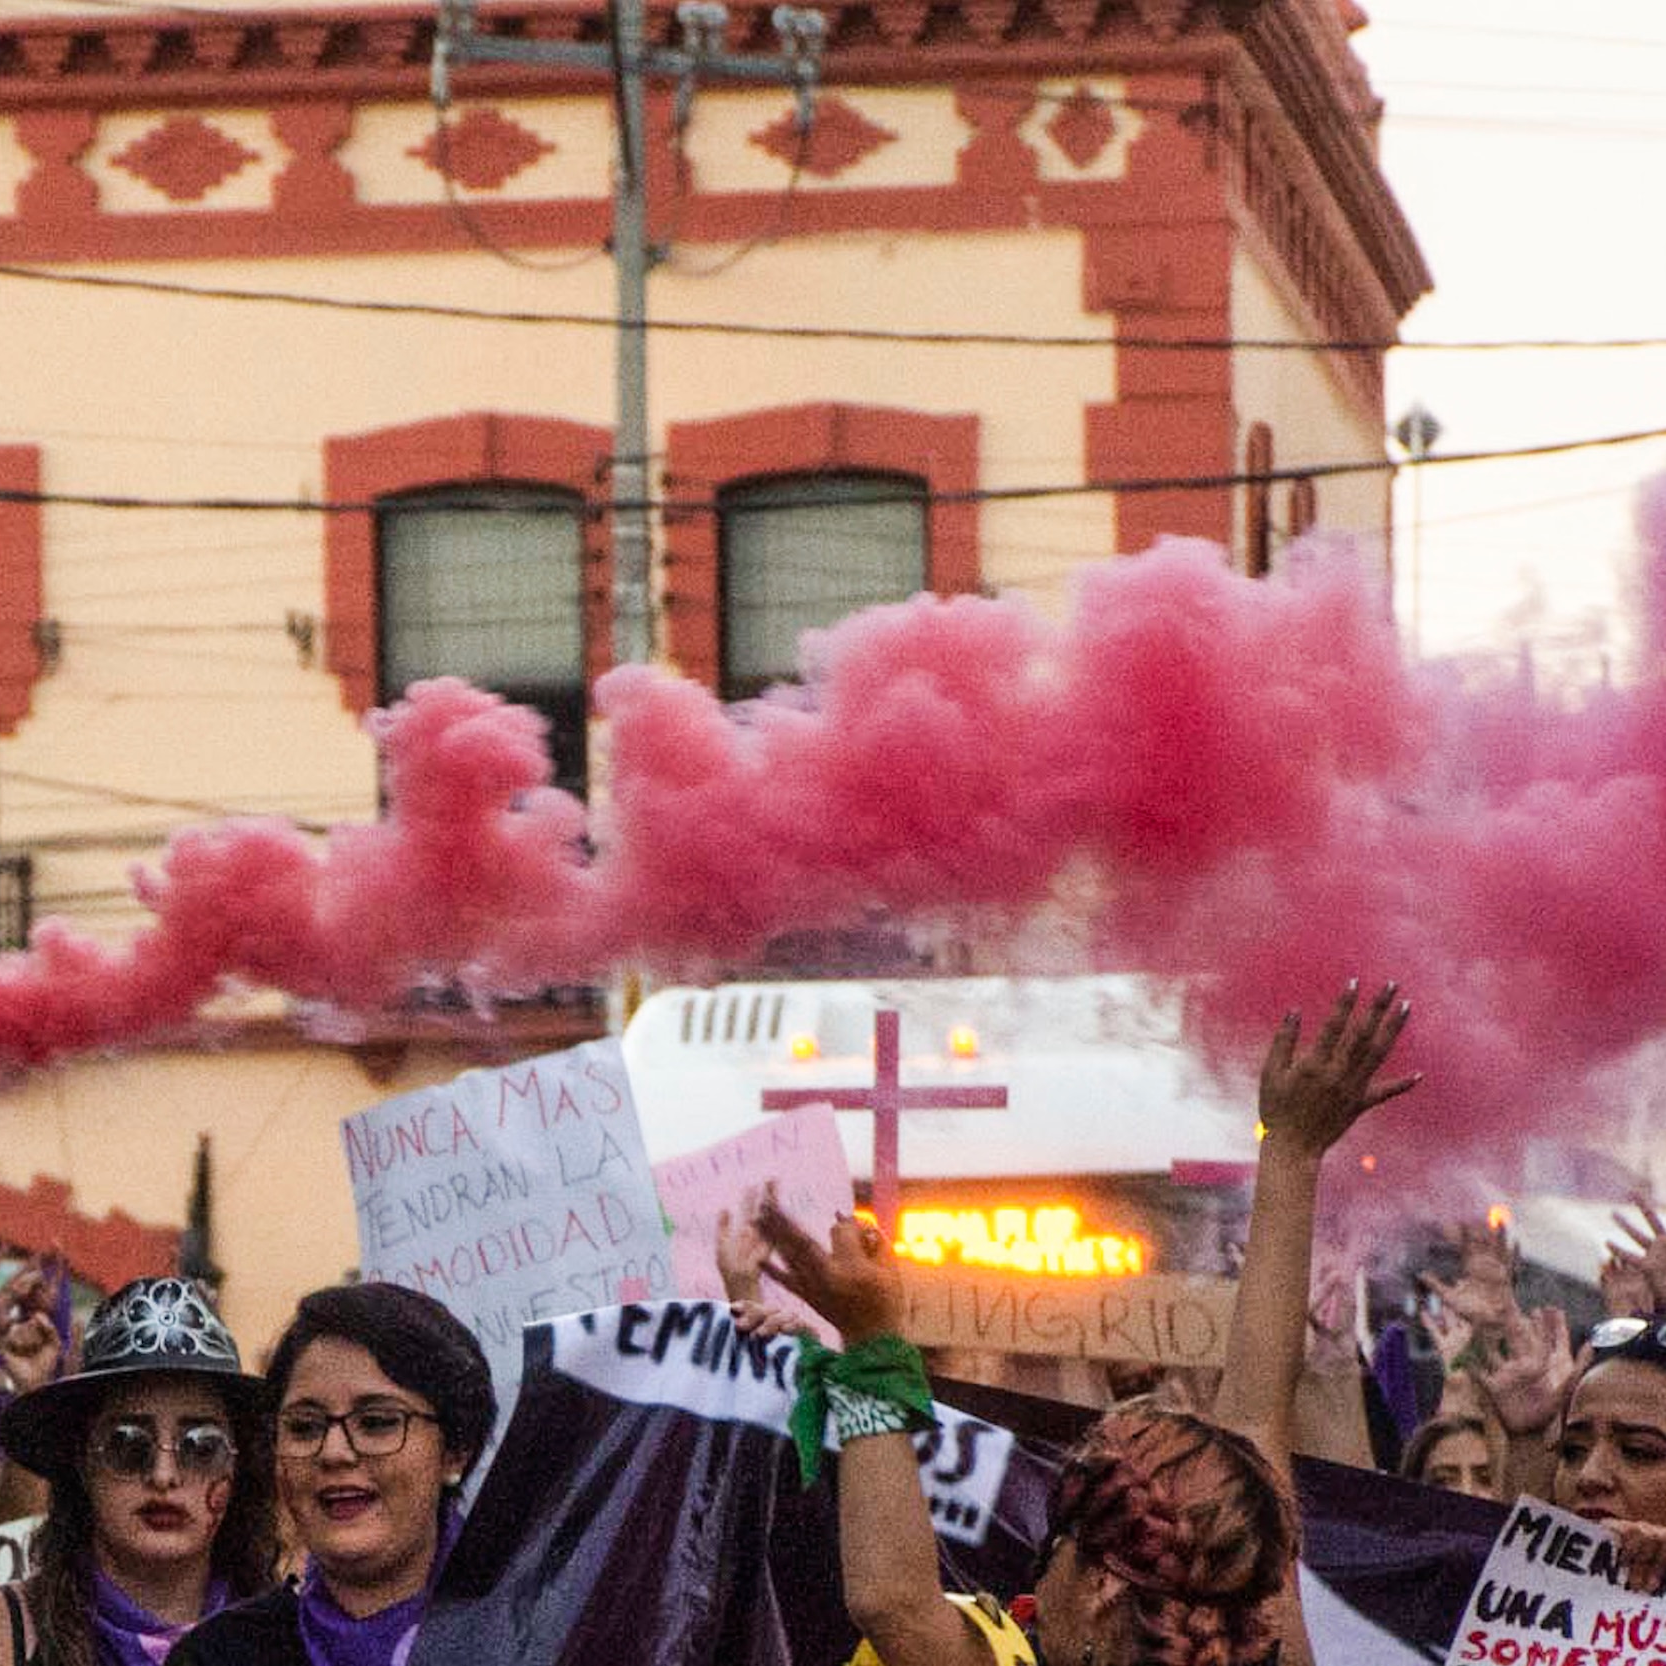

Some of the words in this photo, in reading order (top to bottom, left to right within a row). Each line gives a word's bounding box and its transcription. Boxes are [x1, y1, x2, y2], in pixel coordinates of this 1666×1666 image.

[343, 1102, 480, 1182] NUNCA
[555, 1128, 633, 1187] LA
[366, 1190, 637, 1296] MODIDAD
[1475, 1578, 1573, 1640] UNA
